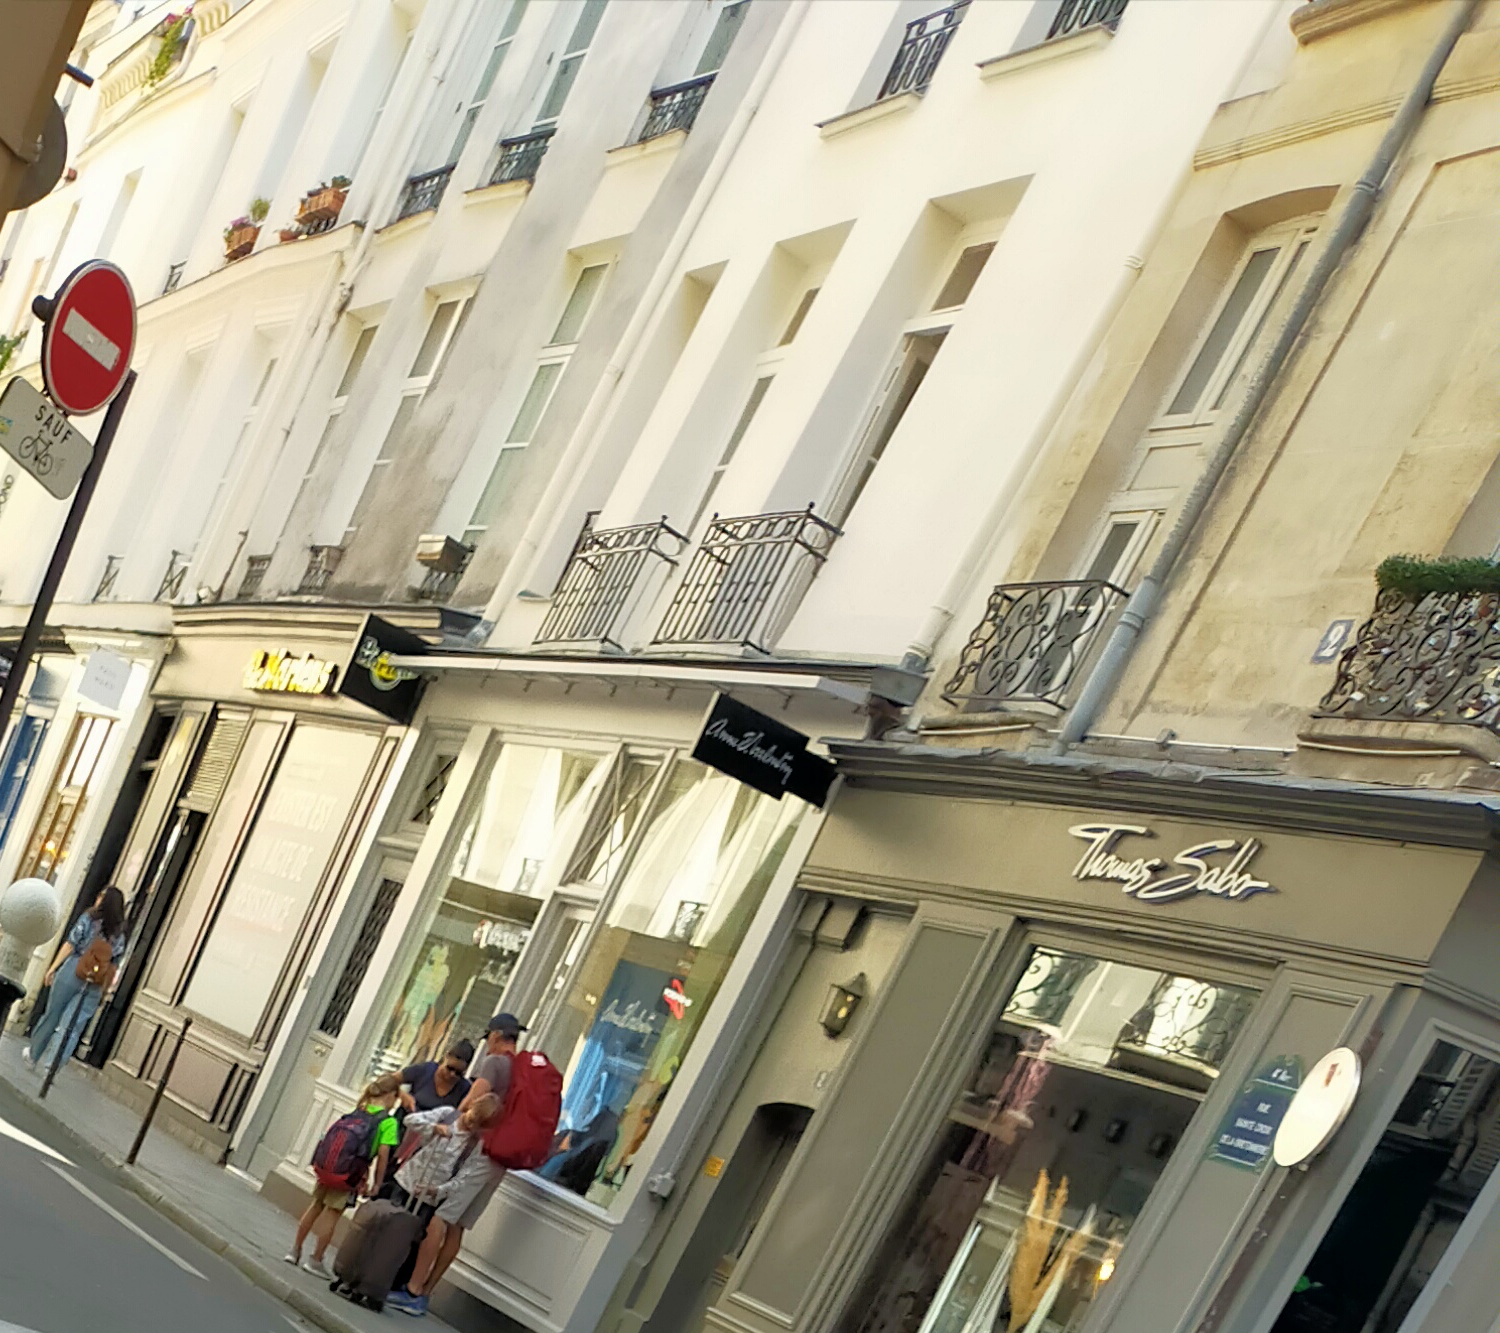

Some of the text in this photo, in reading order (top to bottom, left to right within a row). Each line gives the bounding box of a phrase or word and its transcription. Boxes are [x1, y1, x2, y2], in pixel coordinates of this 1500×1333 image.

[35, 405, 73, 444] SAUF
[1318, 622, 1348, 657] 2
[1068, 823, 1270, 899] Thomas Sabo
